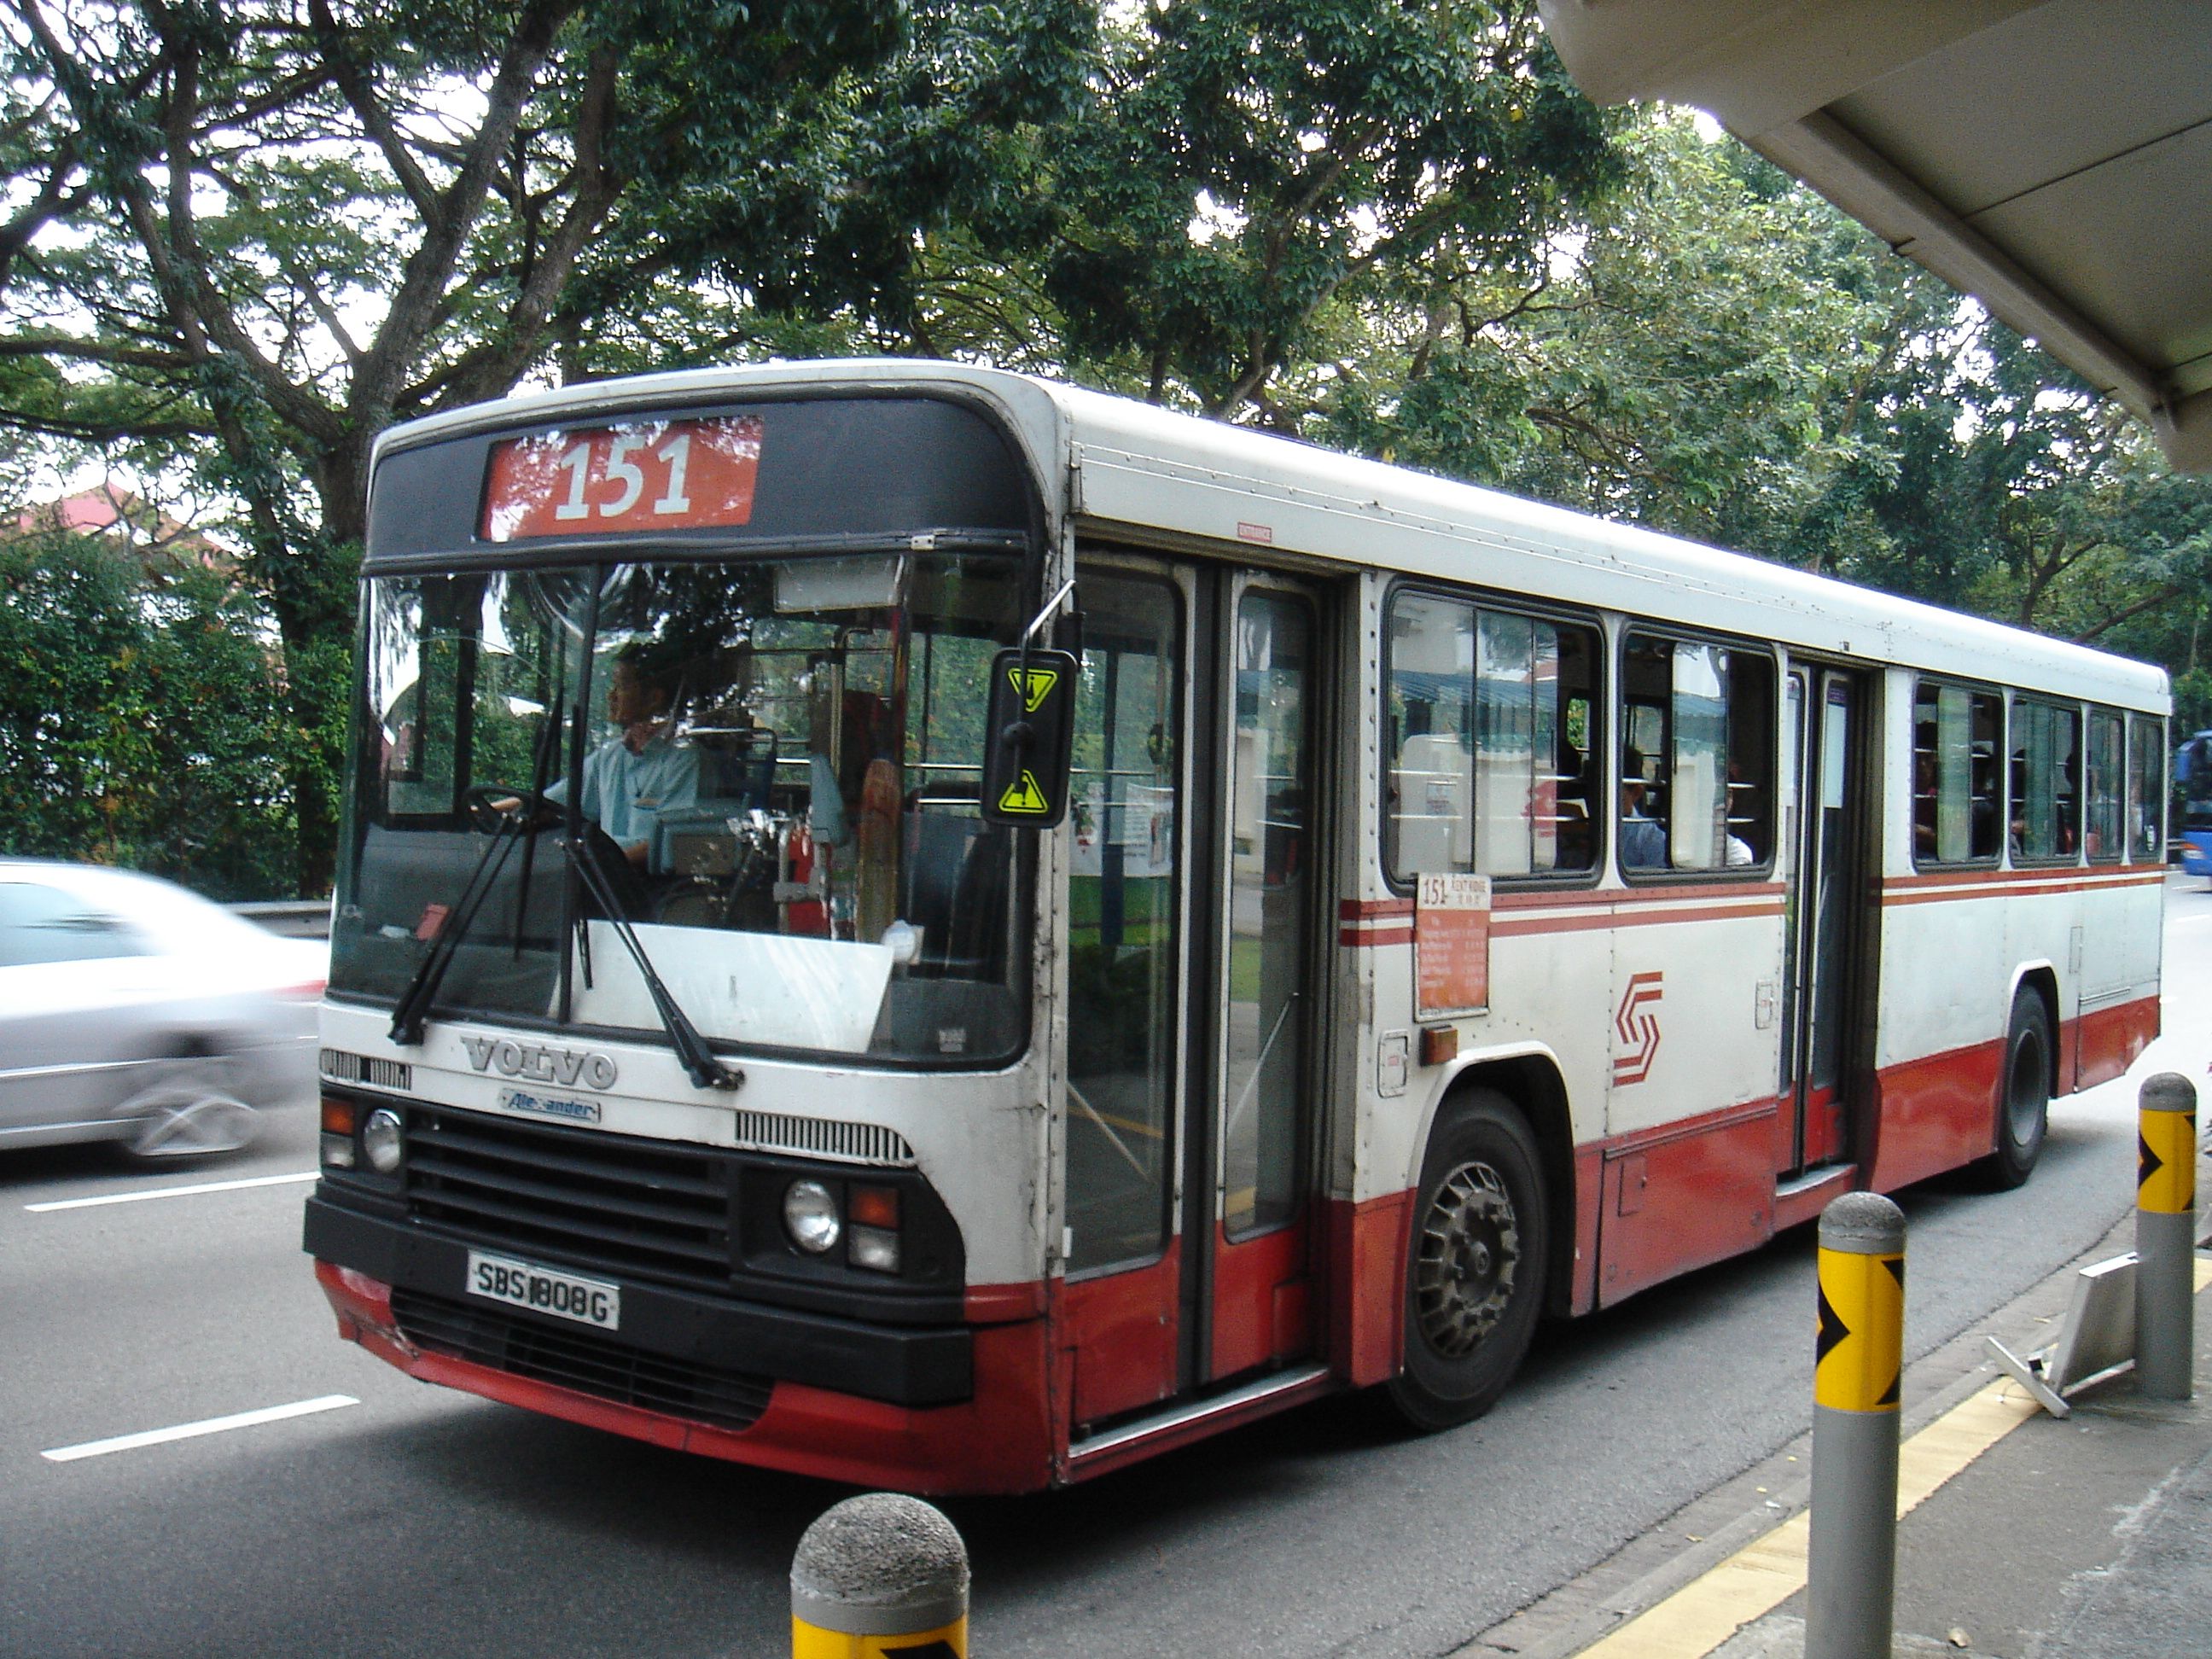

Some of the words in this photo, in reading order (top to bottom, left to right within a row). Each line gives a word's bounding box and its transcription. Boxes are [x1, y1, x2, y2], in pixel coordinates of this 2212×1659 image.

[556, 434, 690, 520] 151
[1423, 879, 1446, 905] 151
[460, 1036, 618, 1090] VOLVO
[478, 1262, 608, 1322] SBS1808G
